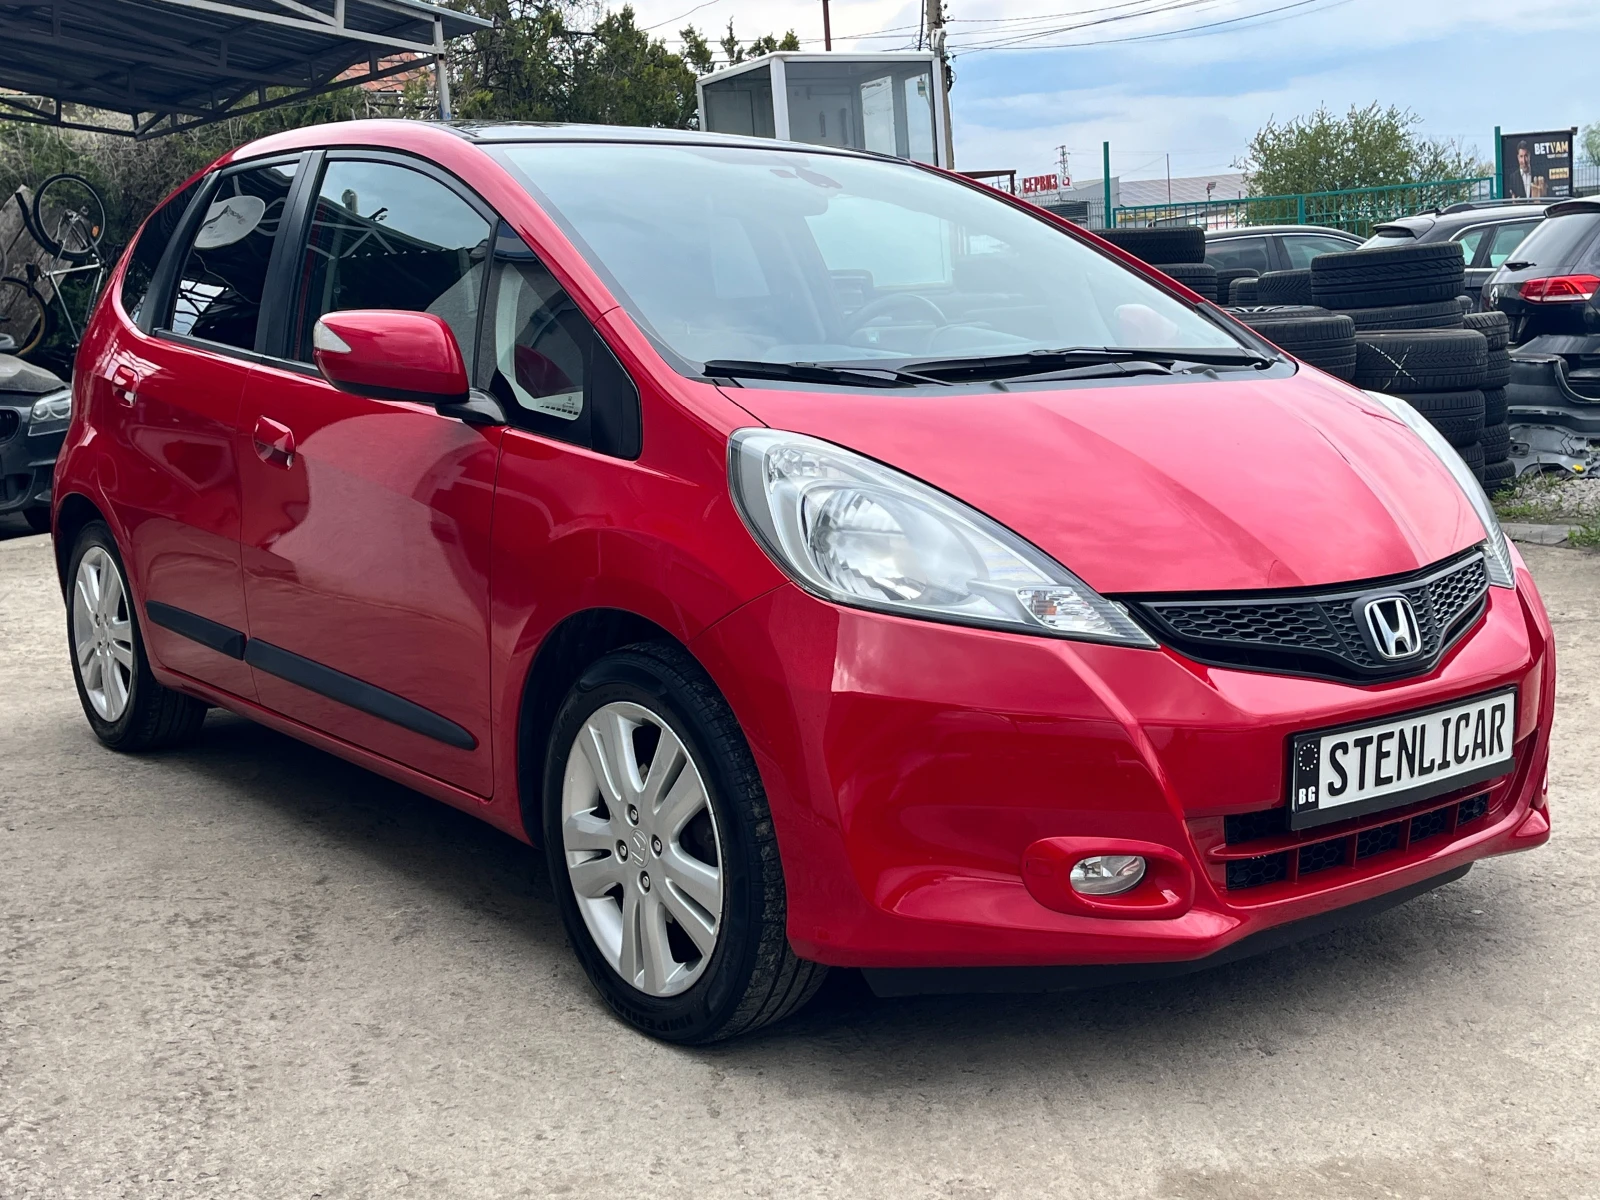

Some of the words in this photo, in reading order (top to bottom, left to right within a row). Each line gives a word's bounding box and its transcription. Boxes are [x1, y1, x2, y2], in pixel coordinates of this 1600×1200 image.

[1024, 174, 1057, 193] СЕРВИЗ
[1327, 703, 1505, 796] STENLICAR
[1298, 786, 1316, 805] BG
